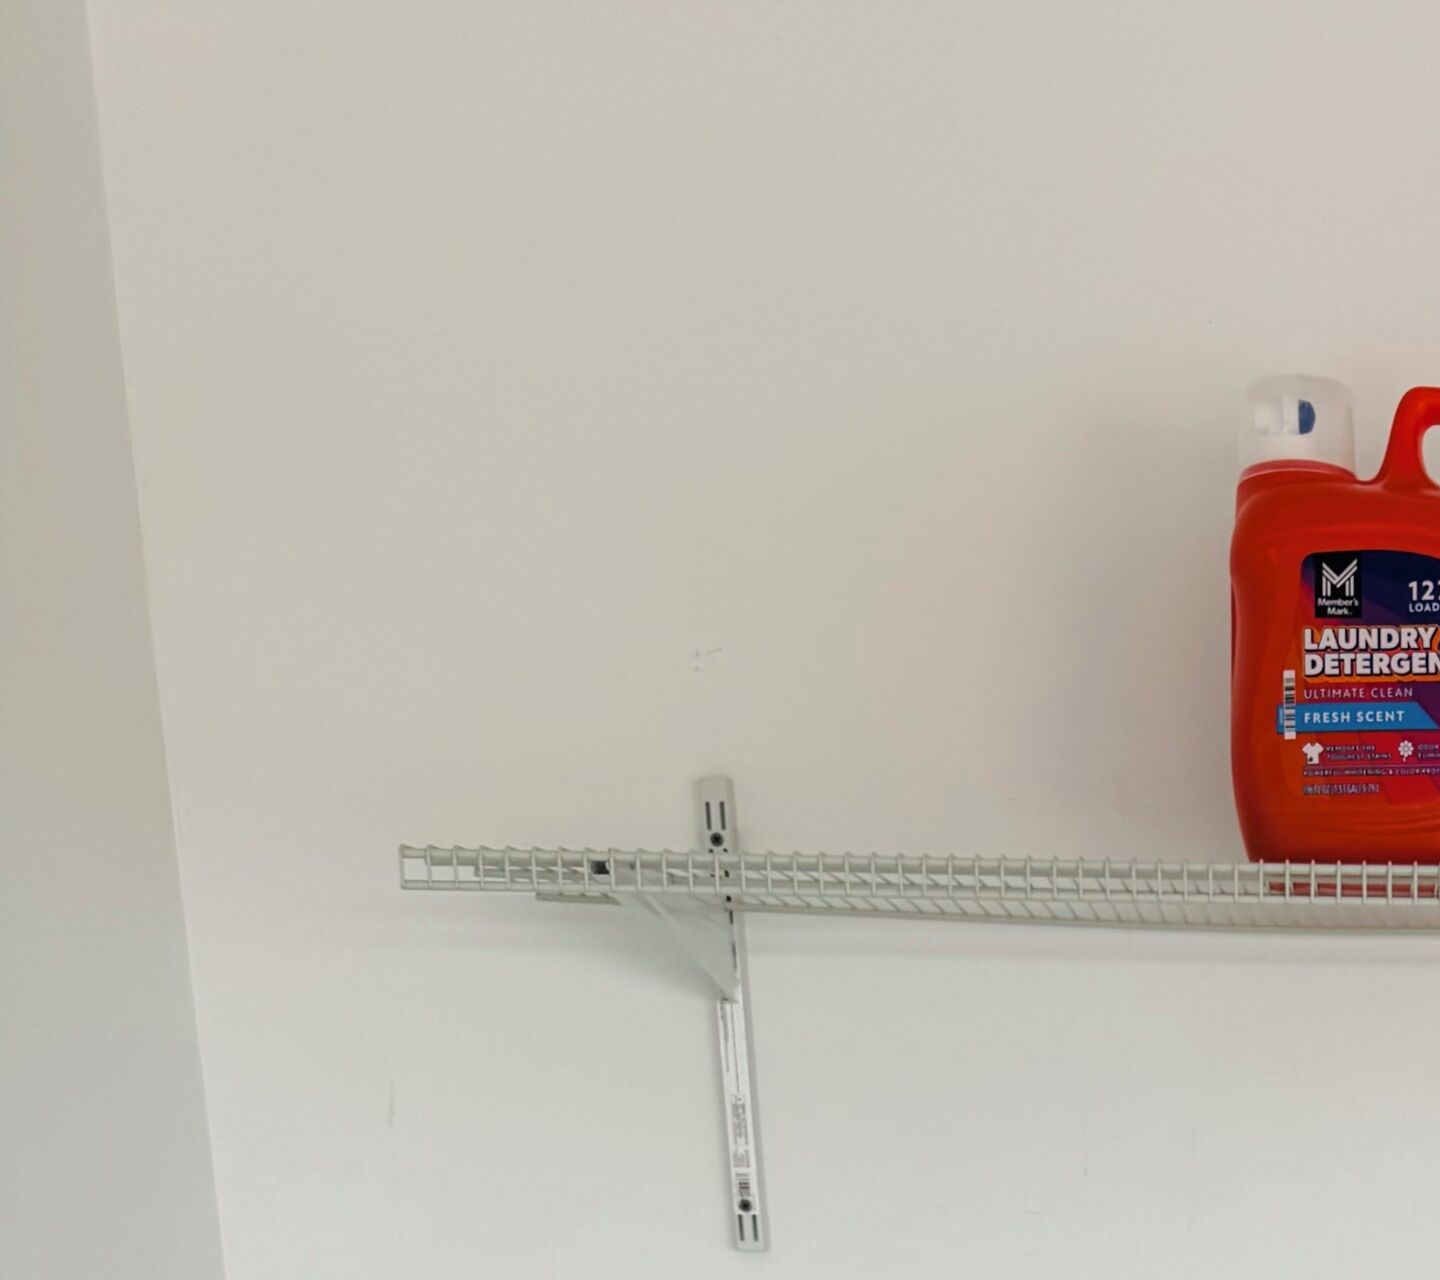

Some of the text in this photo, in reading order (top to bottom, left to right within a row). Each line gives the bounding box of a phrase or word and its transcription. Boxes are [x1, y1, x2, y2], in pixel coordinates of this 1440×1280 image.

[1317, 598, 1359, 607] Member's
[1303, 626, 1438, 651] LAUNDRY
[1303, 687, 1413, 699] ULTIMATE CLEAN
[1303, 710, 1406, 724] FRESH SCENT
